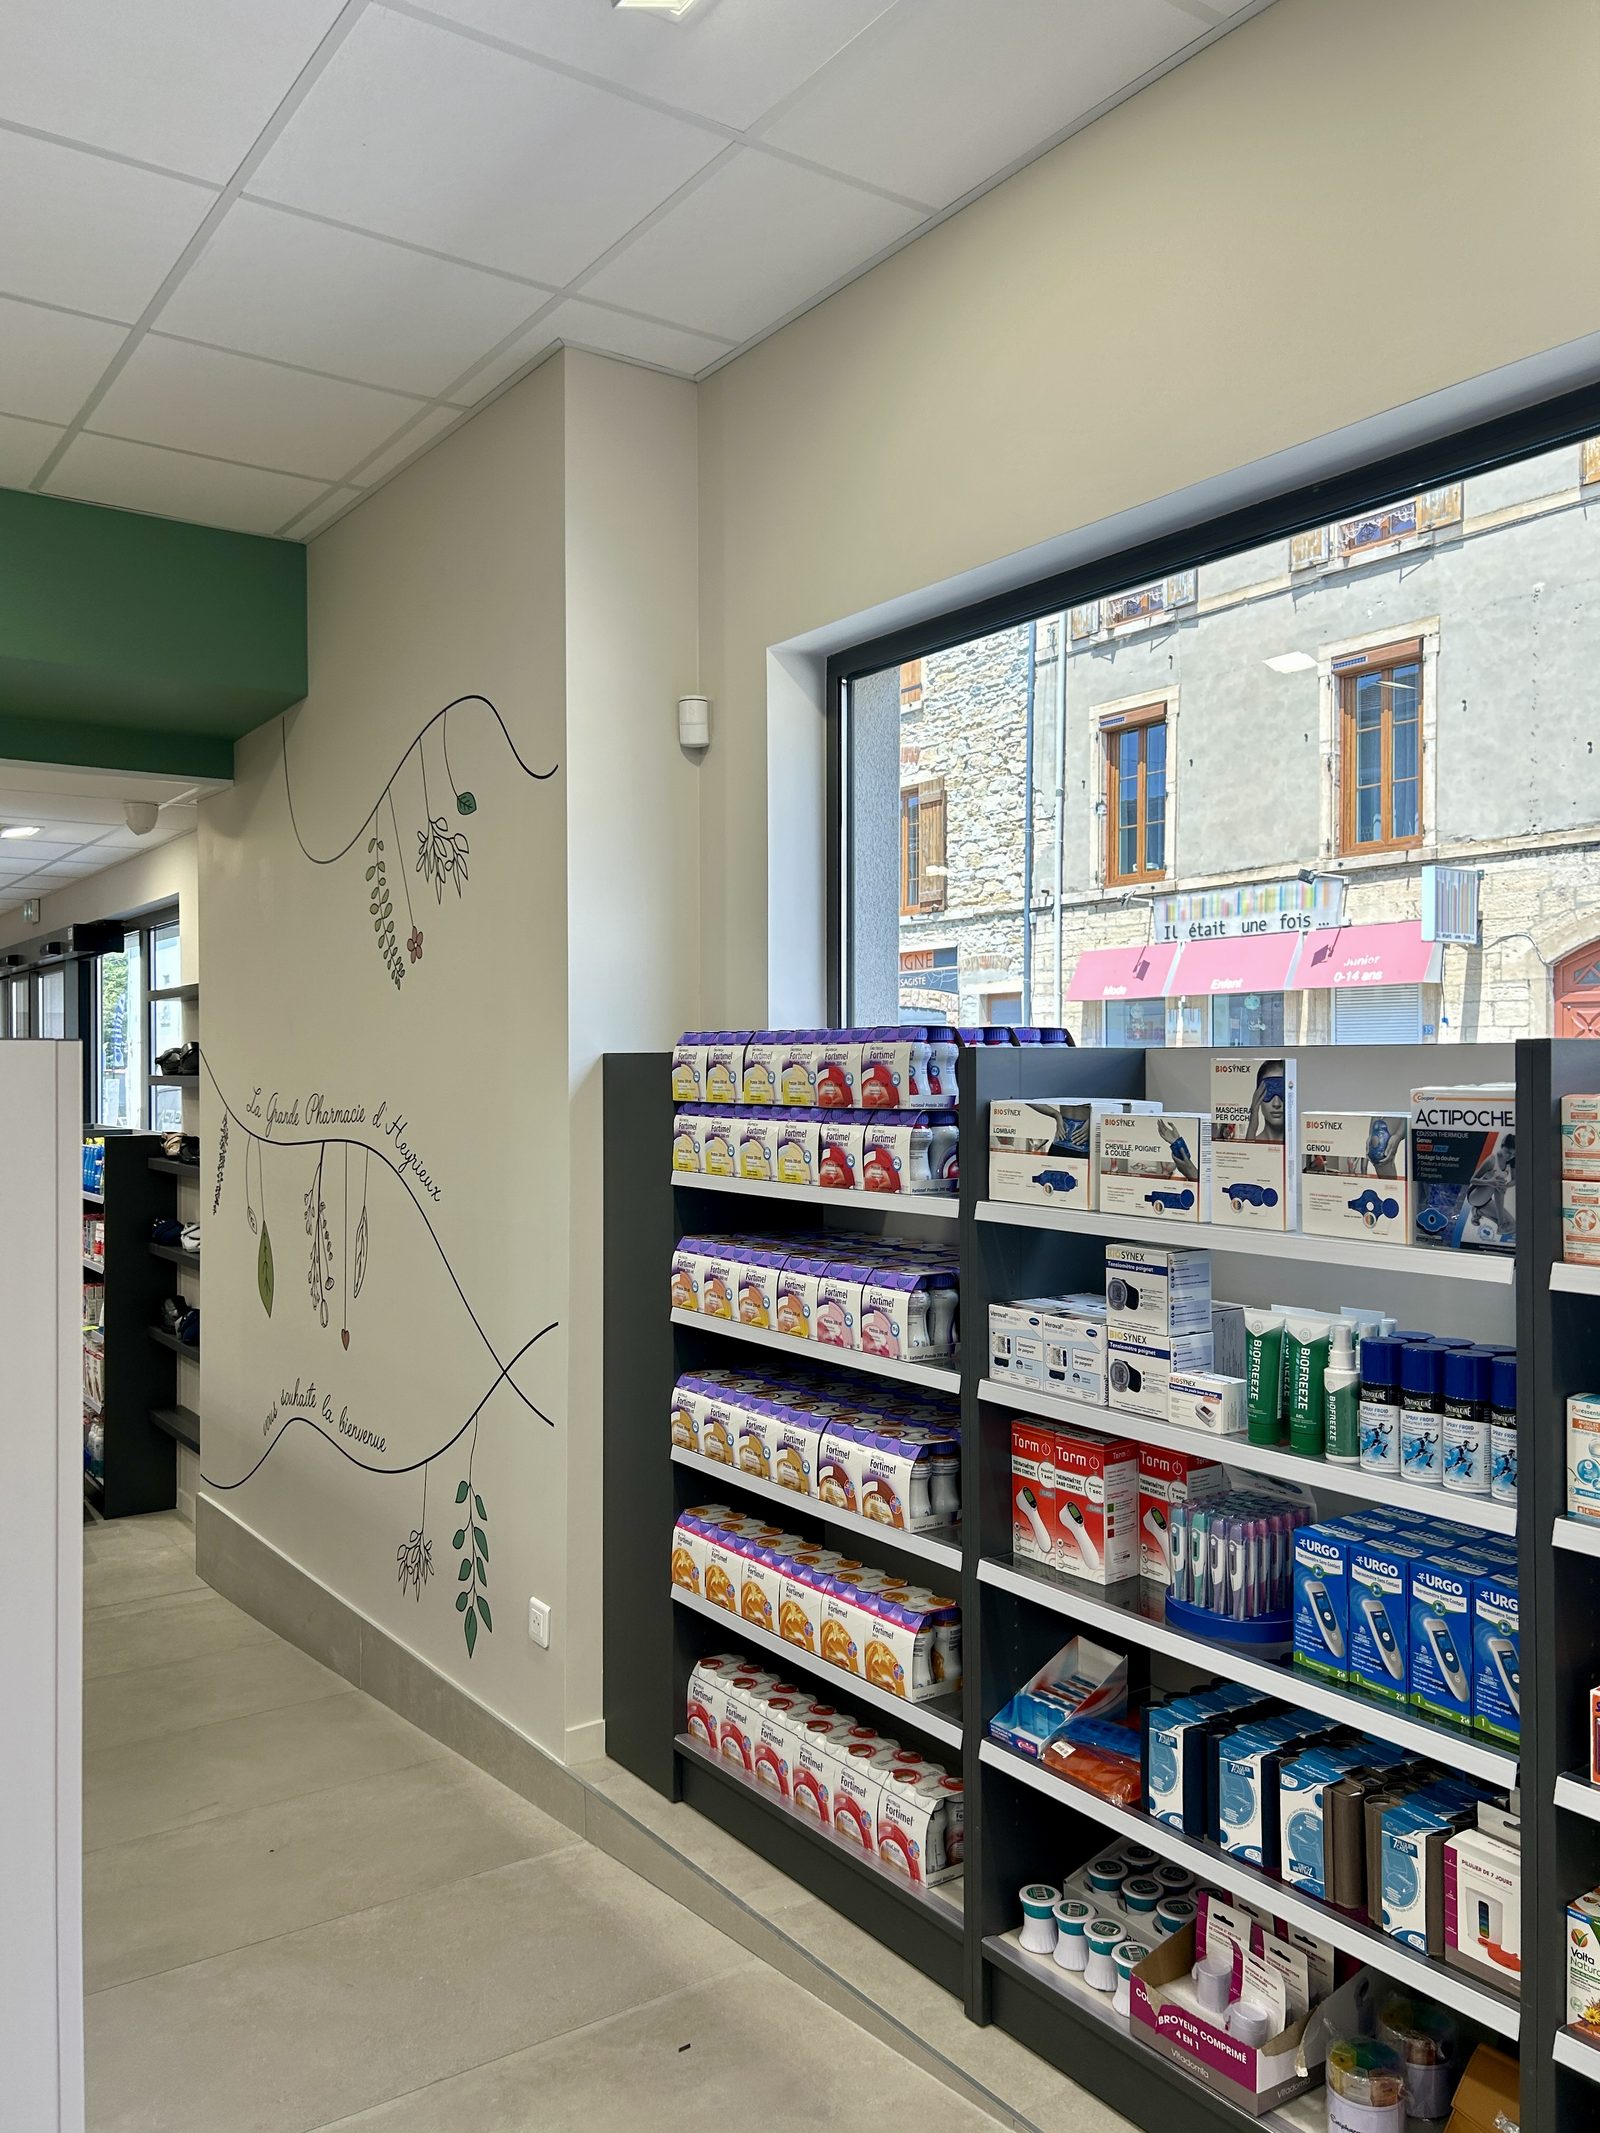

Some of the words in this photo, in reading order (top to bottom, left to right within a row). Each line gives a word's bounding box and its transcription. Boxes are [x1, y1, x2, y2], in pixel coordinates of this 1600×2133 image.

[1164, 925, 1178, 940] Il
[1189, 920, 1226, 938] était
[1242, 919, 1267, 933] une
[1280, 914, 1311, 929] fois
[900, 952, 933, 970] IGNE
[1343, 955, 1381, 967] Junior
[900, 977, 926, 987] SAGISTE
[1333, 971, 1359, 982] 0-14
[1103, 985, 1128, 996] Mode
[1210, 978, 1243, 990] Enfant
[789, 1051, 812, 1061] Fortimel
[825, 1051, 848, 1061] Fortimel
[869, 1050, 896, 1060] Fortimel
[1215, 1064, 1251, 1073] BIOSYNEX
[246, 1087, 262, 1118] La
[265, 1092, 299, 1137] Grande
[305, 1093, 365, 1125] Pharmacie
[993, 1108, 1021, 1117] BIOSYNEX
[1216, 1106, 1251, 1114] MASCHERA
[1104, 1118, 1135, 1127] BIOSYNEX
[1216, 1113, 1229, 1121] PER
[1230, 1114, 1250, 1122] OCCH
[1415, 1109, 1516, 1127] ACTIPOCHE
[746, 1126, 768, 1135] Fortimel
[1306, 1120, 1343, 1130] BIOSYNEX
[784, 1129, 807, 1138] Fortimel
[826, 1132, 851, 1141] Fortimel
[871, 1134, 897, 1143] Fortimel
[1110, 1149, 1131, 1157] COUDE
[1135, 1145, 1161, 1153] POIGNET
[1306, 1144, 1331, 1152] GENOU
[1107, 1248, 1145, 1262] BIOSYNEX
[709, 1265, 730, 1276] Fortimel
[745, 1272, 767, 1284] Fortimel
[784, 1280, 806, 1292] Fortimel
[824, 1287, 848, 1299] Fortimel
[869, 1295, 894, 1308] Fortimel
[1109, 1330, 1147, 1345] BIOSYNEX
[1250, 1339, 1262, 1401] BIOFREEZE
[1170, 1376, 1196, 1387] BIOSYNEX
[1298, 1347, 1311, 1411] BIOFREEZE
[280, 1377, 317, 1409] souhaite
[321, 1394, 334, 1423] la
[339, 1405, 386, 1452] bienvenue
[710, 1407, 731, 1421] Fortimel
[1329, 1395, 1337, 1441] BIOFREEZE
[745, 1419, 768, 1434] Fortimel
[1459, 1423, 1474, 1431] FROID
[783, 1432, 806, 1447] Fortimel
[1012, 1432, 1039, 1453] Torm
[826, 1444, 851, 1460] Fortimel
[1056, 1446, 1087, 1467] Torm
[1112, 1451, 1126, 1460] Torm
[870, 1458, 897, 1475] Fortimel
[1140, 1451, 1169, 1472] Torm
[1022, 1468, 1036, 1478] CONTACT
[1066, 1482, 1083, 1492] CONTACT
[1150, 1488, 1166, 1498] CONTACT
[1307, 1539, 1340, 1559] URGO
[1363, 1556, 1399, 1577] URGO
[1425, 1573, 1463, 1595] URGO
[1489, 1592, 1518, 1611] URG
[827, 1603, 848, 1619] Fortimel
[872, 1624, 894, 1640] Fortimel
[692, 1686, 714, 1705] Fortimel
[725, 1705, 747, 1724] Fortimel
[760, 1727, 784, 1747] Fortimel
[799, 1750, 823, 1772] Fortimel
[840, 1775, 867, 1798] Fortimel
[885, 1803, 914, 1827] Fortimel
[1495, 1875, 1512, 1886] JOURS
[1570, 1947, 1595, 1966] Volta
[1158, 2015, 1199, 2036] BROYEUR
[1200, 2031, 1247, 2064] COMPRIMÉ
[1182, 2035, 1193, 2046] EN
[1171, 2047, 1209, 2079] Vitadomia
[1277, 2077, 1311, 2098] Vitadomia
